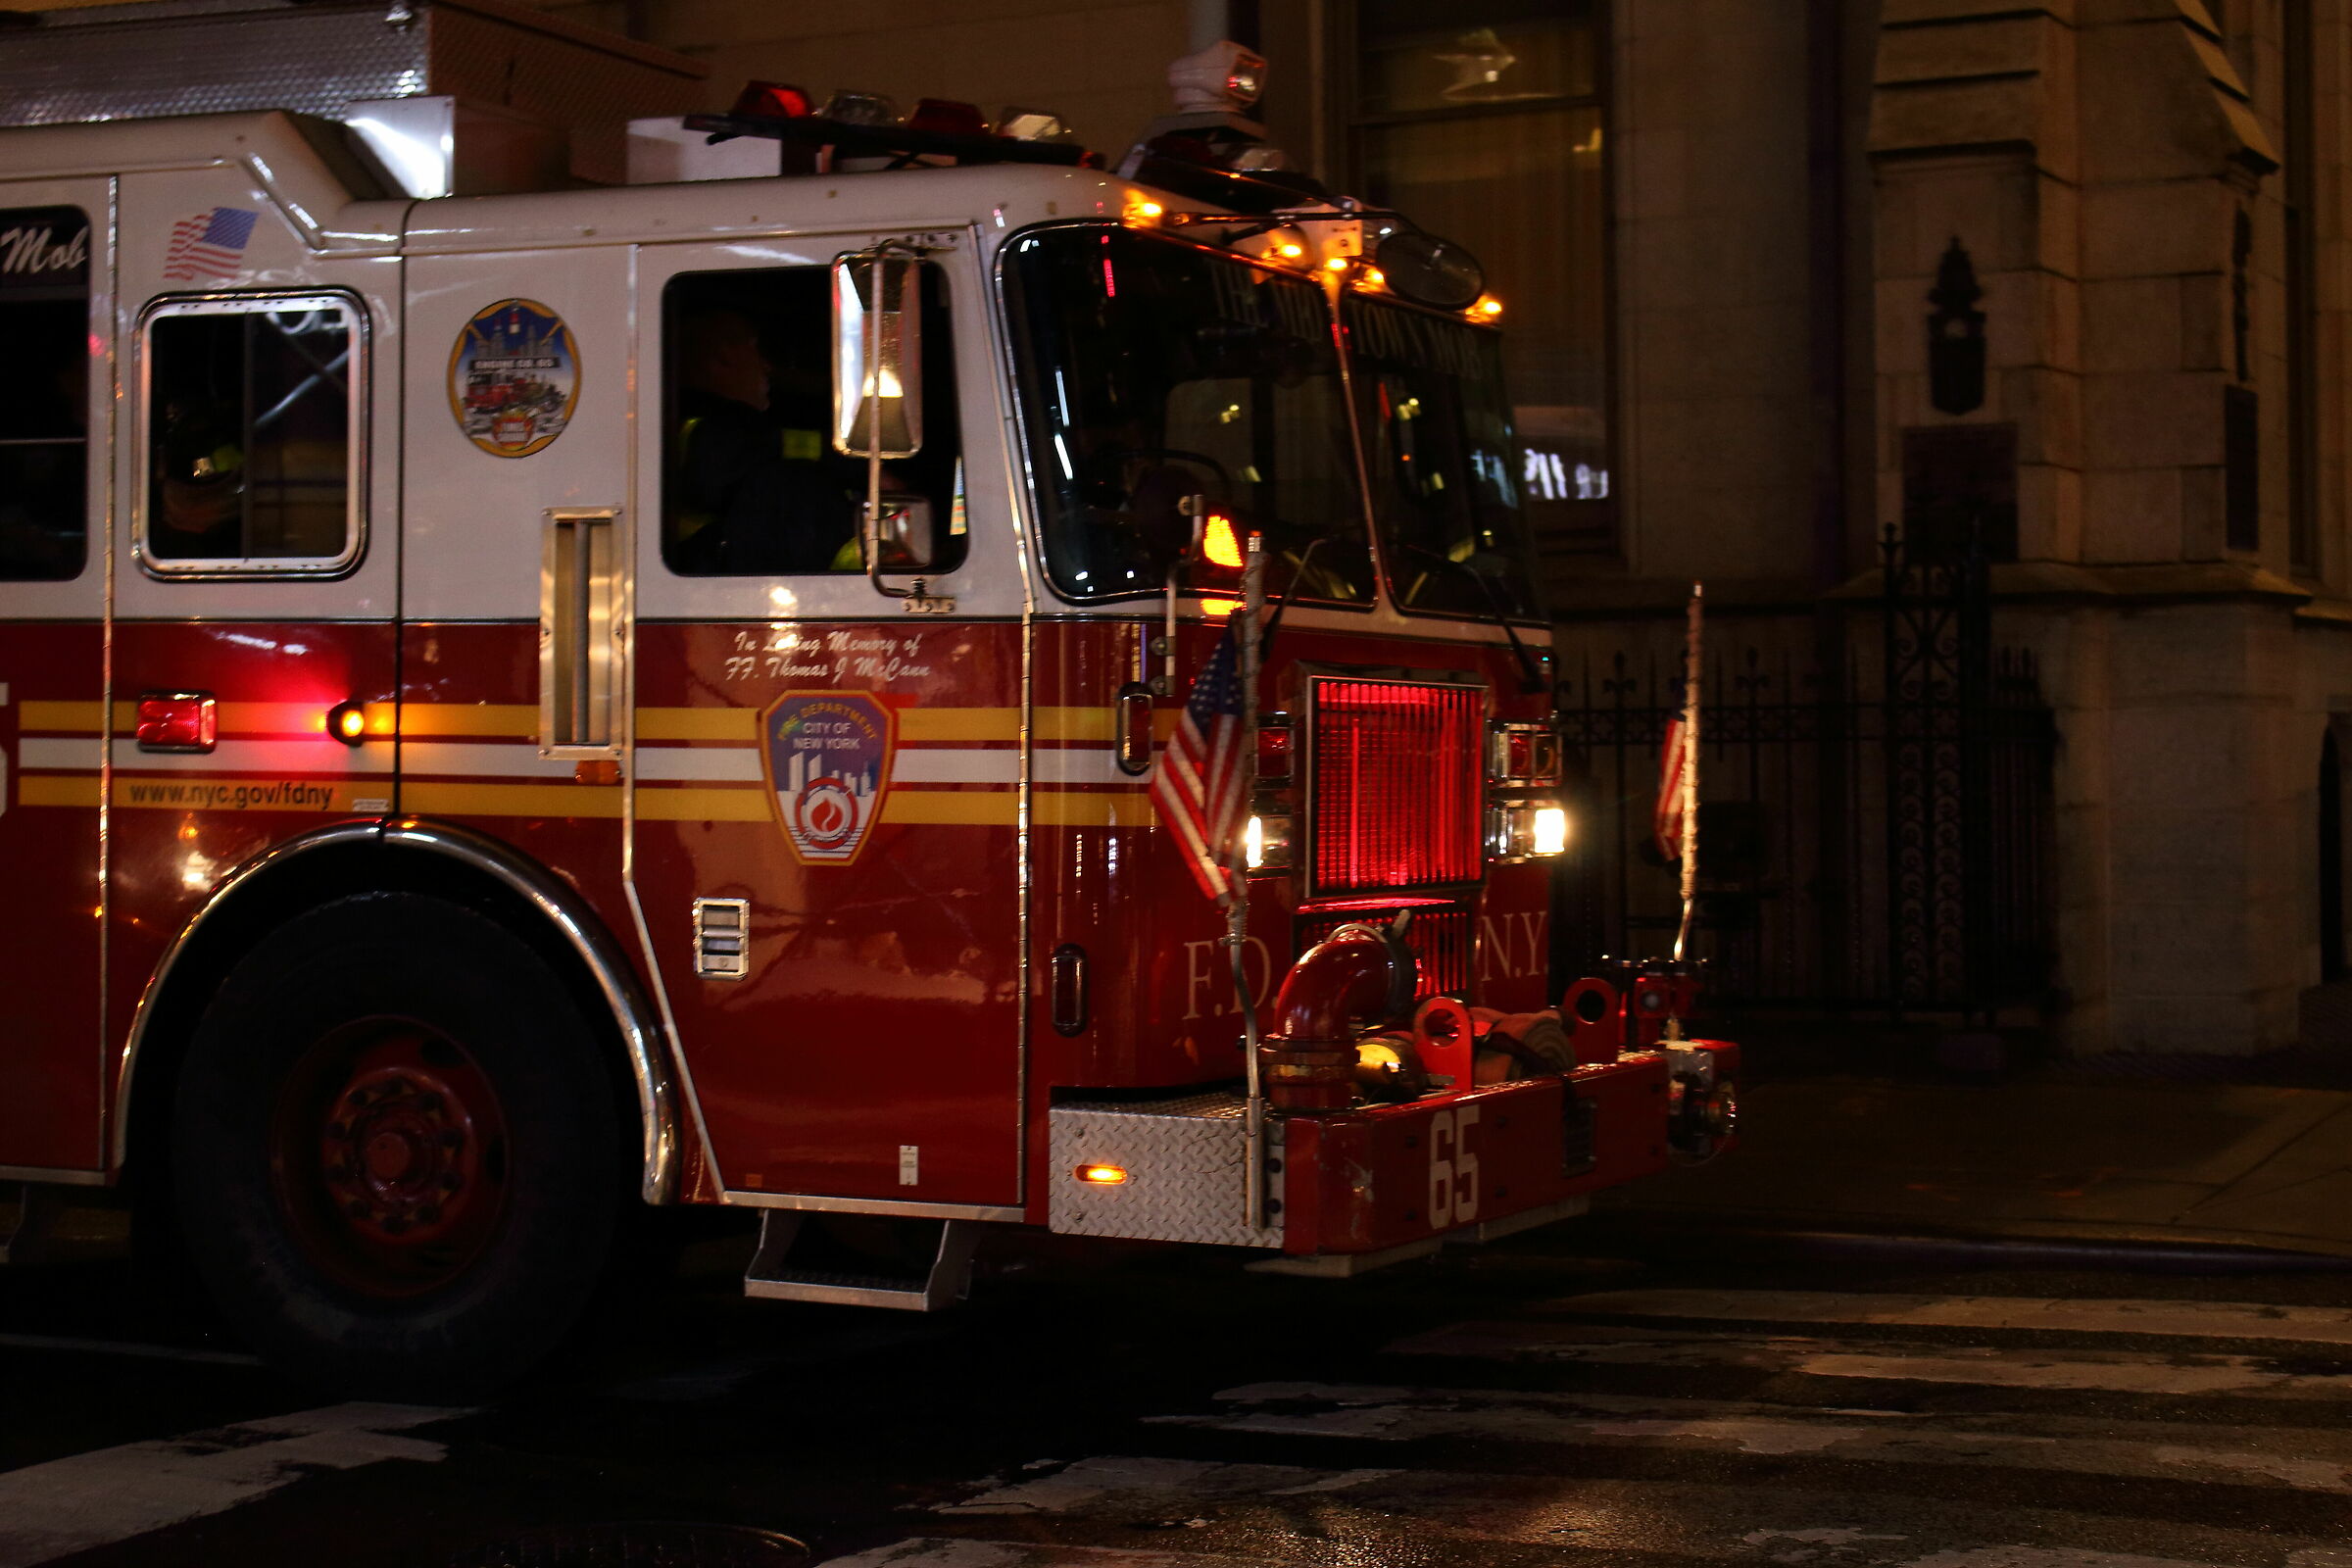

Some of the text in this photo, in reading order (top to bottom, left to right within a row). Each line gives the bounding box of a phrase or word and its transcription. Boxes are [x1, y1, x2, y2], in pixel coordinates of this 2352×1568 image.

[0, 224, 88, 274] Mob
[735, 630, 923, 659] In Ling Memory of
[764, 655, 829, 678] Thomas
[832, 656, 849, 685] J
[853, 656, 931, 683] McCann
[803, 721, 853, 736] CITY OF
[792, 737, 861, 751] NEW YORK
[129, 781, 334, 810] www.nyc.gov/fdny
[1428, 1104, 1481, 1231] 65
